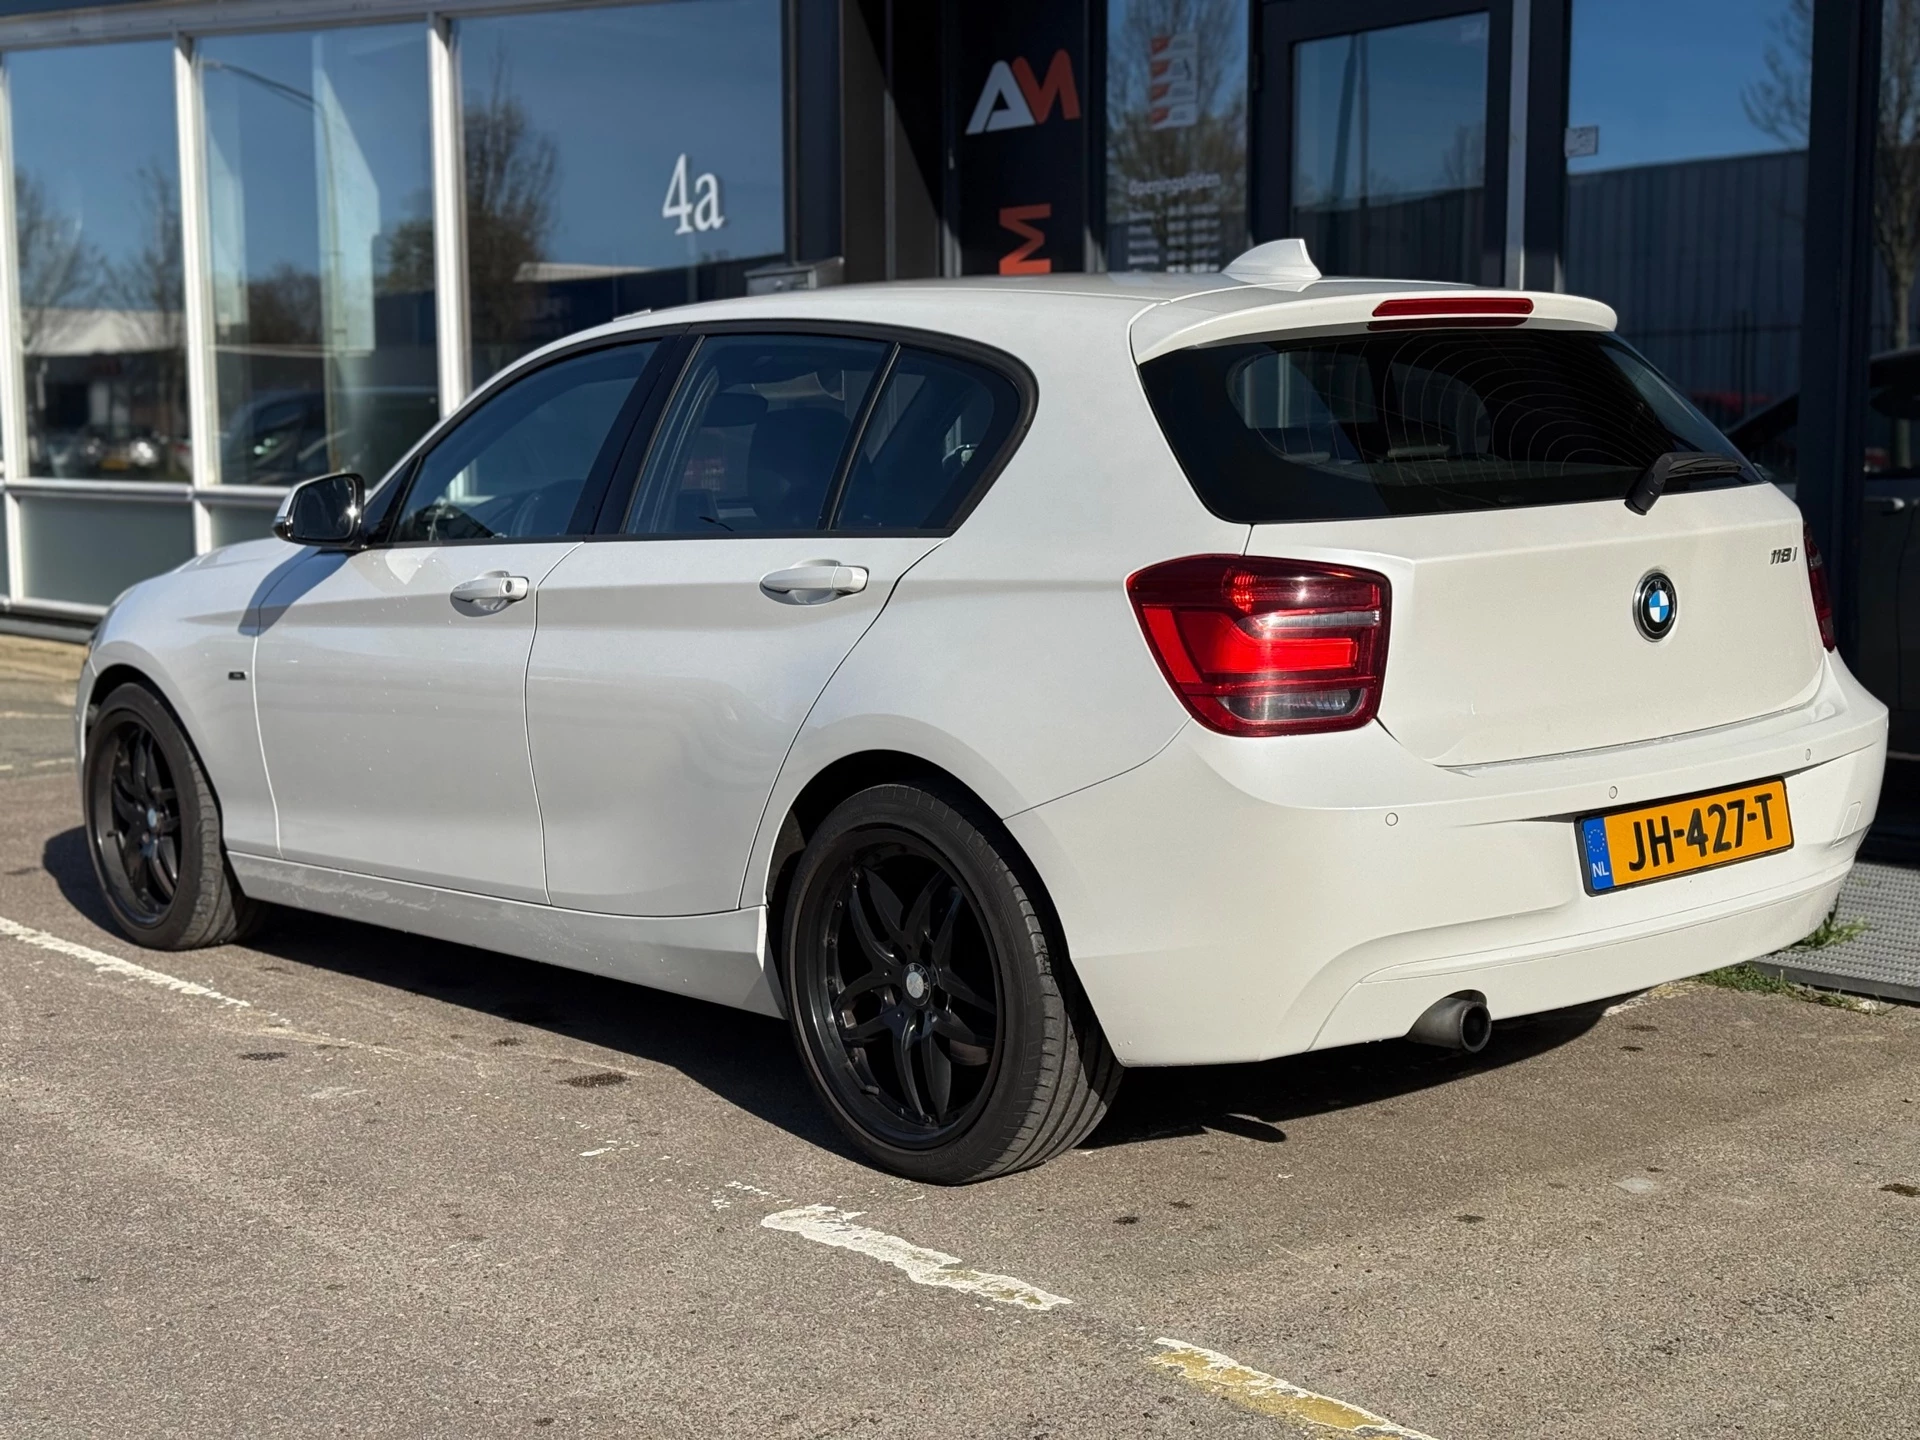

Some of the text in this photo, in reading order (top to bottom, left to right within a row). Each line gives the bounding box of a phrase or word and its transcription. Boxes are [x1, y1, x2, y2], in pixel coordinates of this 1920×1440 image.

[662, 152, 725, 235] 4a
[1628, 793, 1773, 872] JH-427-T
[1592, 861, 1610, 878] NL
[908, 963, 930, 990] BMW
